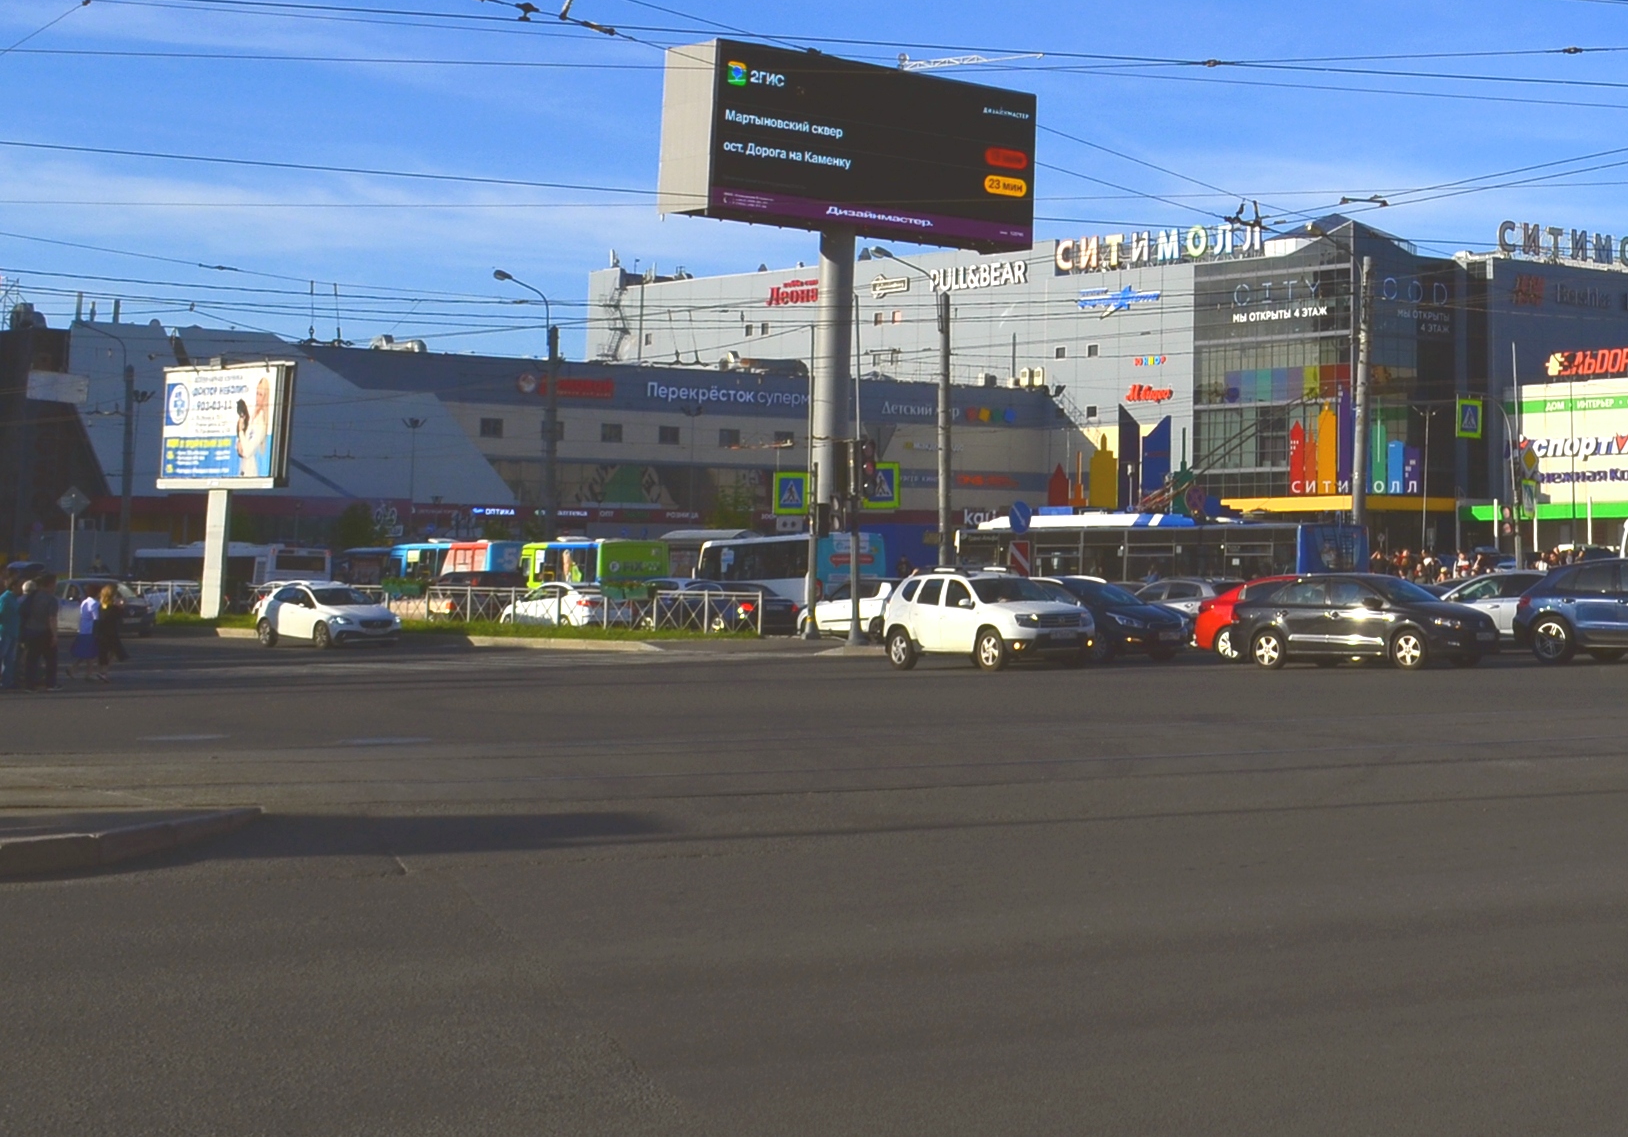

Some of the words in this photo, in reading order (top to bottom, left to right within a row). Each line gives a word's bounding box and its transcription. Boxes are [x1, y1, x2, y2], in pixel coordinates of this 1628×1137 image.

[750, 69, 785, 87] 2ГИС
[725, 108, 810, 134] Мартыновский
[811, 124, 844, 139] сквер
[723, 140, 744, 154] ост.
[745, 142, 787, 160] Дорога
[789, 150, 802, 162] на
[804, 150, 852, 170] Каменку
[988, 177, 1001, 191] 23
[1002, 181, 1023, 193] мин
[1056, 224, 1262, 271] СИТИМОЛЛ
[930, 261, 1028, 292] PULL&BEAR
[766, 286, 819, 307] Леона
[1233, 279, 1321, 307] CITY
[1383, 277, 1448, 306] OOD
[1232, 313, 1247, 324] МЫ
[1249, 309, 1292, 322] ОТКРЫТЫ
[1294, 309, 1301, 318] 4
[1301, 306, 1328, 318] ЭТАЖ
[647, 381, 755, 403] Перекрёсток
[757, 389, 809, 406] суперм
[881, 401, 933, 417] Детский
[1545, 401, 1565, 411] ДОМ
[1576, 398, 1615, 409] ИНТЕРЬЕР
[1291, 480, 1418, 494] СИТИОЛЛ
[1538, 472, 1608, 484] нежная
[485, 508, 515, 516] ОПТИКА
